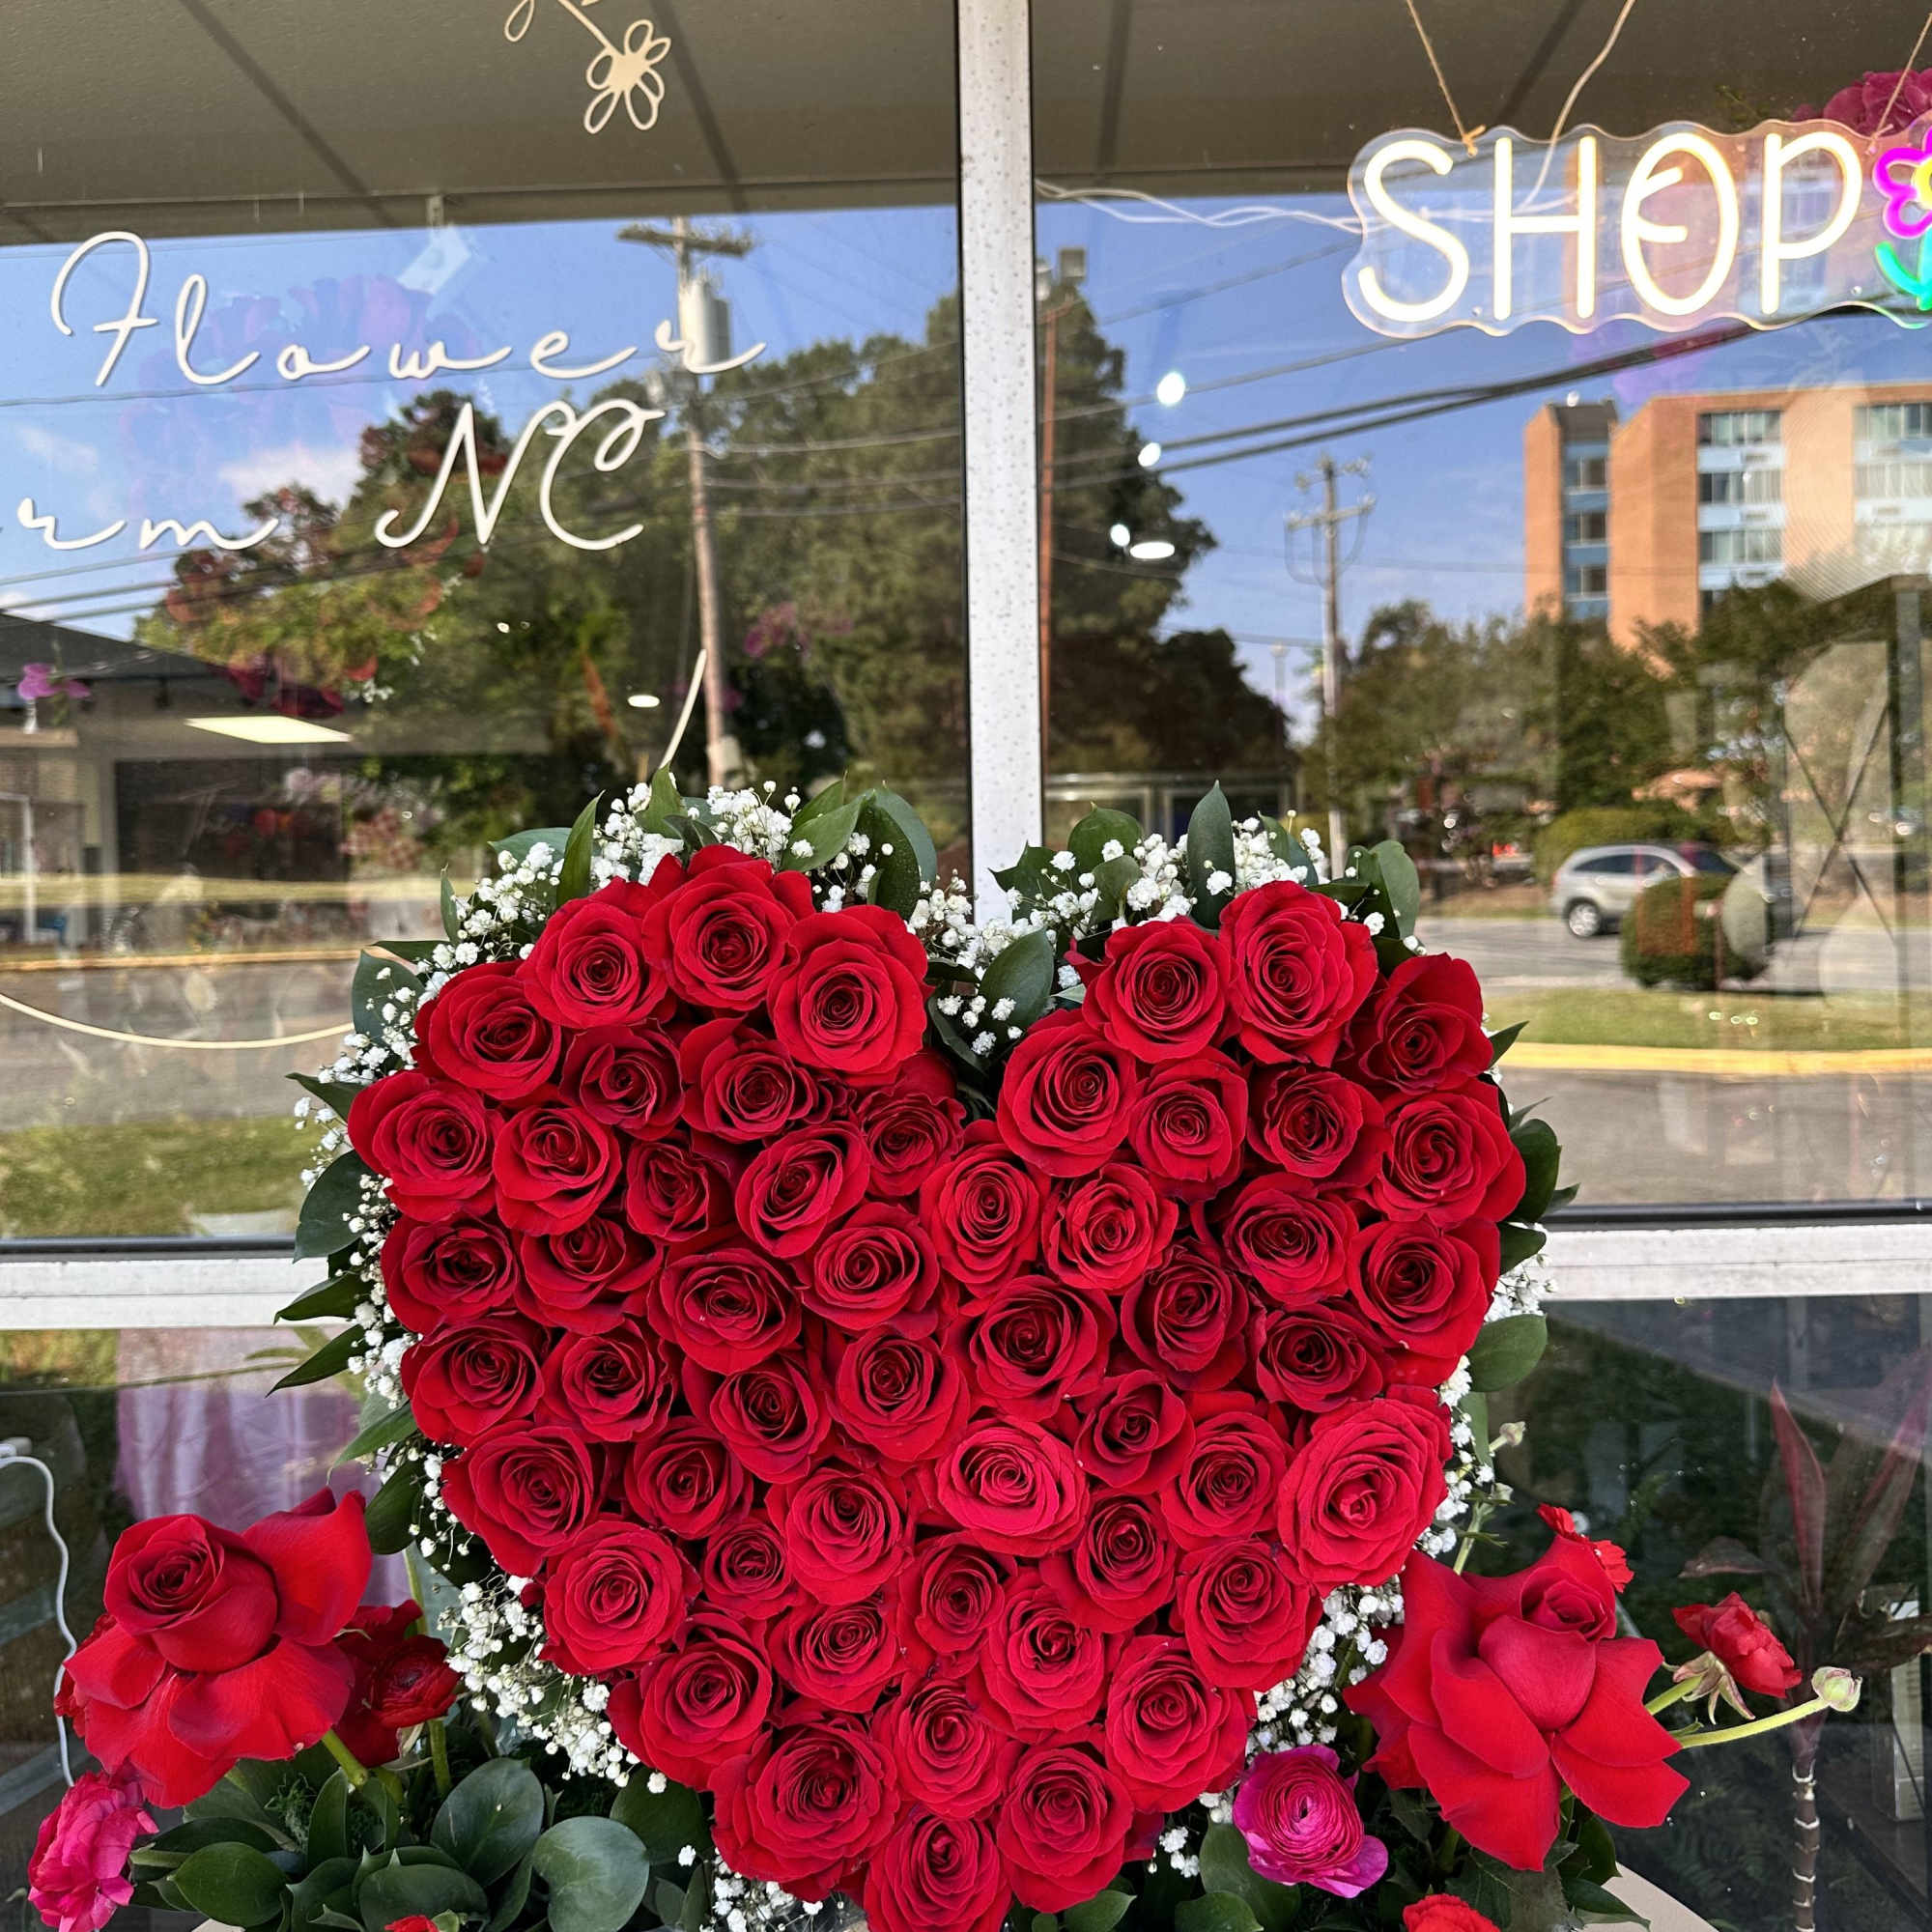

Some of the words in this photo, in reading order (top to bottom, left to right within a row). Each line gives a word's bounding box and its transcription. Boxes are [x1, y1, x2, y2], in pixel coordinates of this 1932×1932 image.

[1358, 131, 1862, 322] SHOP
[51, 231, 766, 385] Flower
[374, 398, 666, 551] NC
